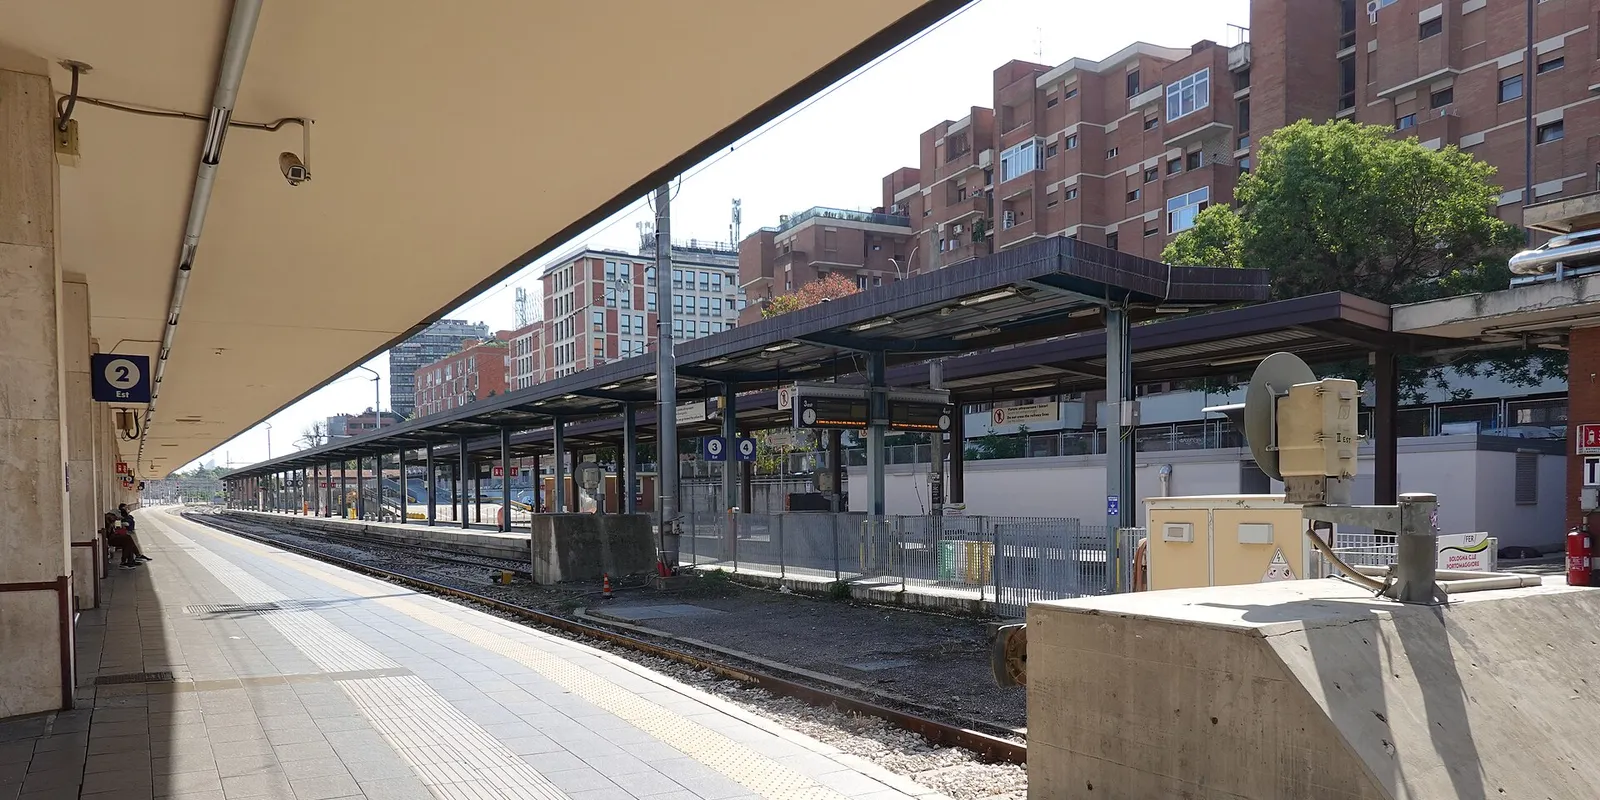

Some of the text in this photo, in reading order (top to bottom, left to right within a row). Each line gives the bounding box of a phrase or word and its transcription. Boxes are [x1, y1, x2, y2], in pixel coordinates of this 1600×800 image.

[115, 366, 129, 382] 2
[712, 443, 718, 452] 3
[743, 444, 749, 453] 4
[1586, 459, 1600, 484] T
[1465, 535, 1475, 543] FER
[1446, 561, 1480, 569] PORTOMAGGIORE
